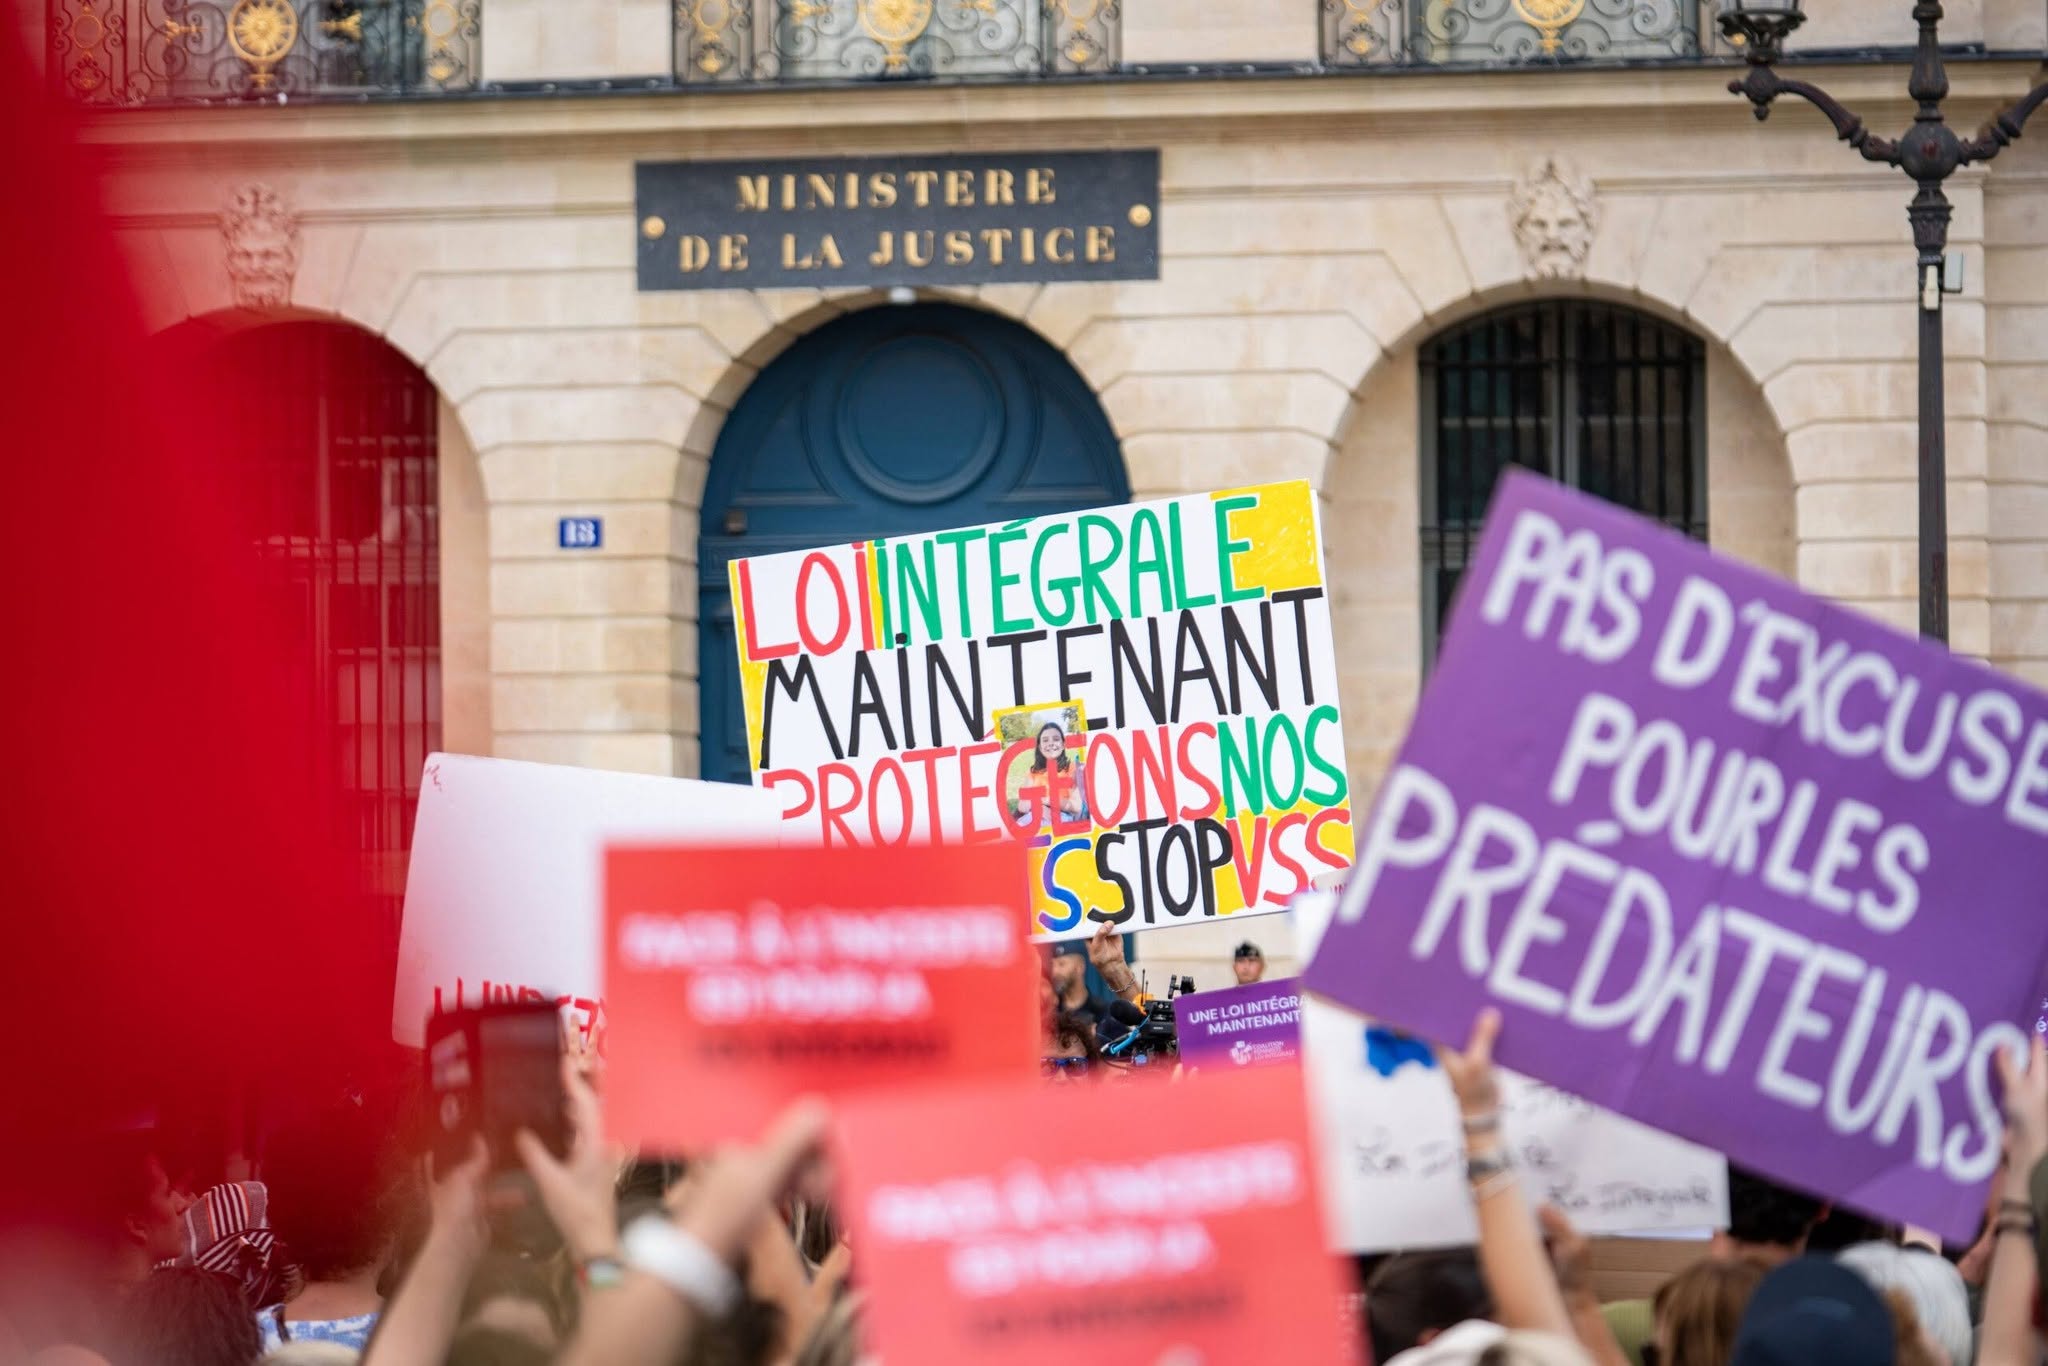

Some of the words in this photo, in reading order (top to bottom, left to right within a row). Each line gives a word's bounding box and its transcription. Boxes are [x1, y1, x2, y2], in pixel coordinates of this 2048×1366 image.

[736, 168, 1056, 212] MINISTERE
[679, 233, 749, 272] DE
[782, 232, 844, 270] LA
[869, 225, 1116, 268] JUSTICE
[1480, 508, 1655, 664] PAS
[760, 587, 1323, 769] MAINTENANT
[1216, 703, 1348, 818] NOS
[1086, 817, 1233, 924] STOP
[1225, 808, 1352, 907] VSS
[1189, 1008, 1218, 1024] UNE
[1221, 1004, 1245, 1019] LOI
[1208, 1010, 1302, 1036] MAINTENANT
[1337, 764, 2031, 1183] PRÉDATEURS
